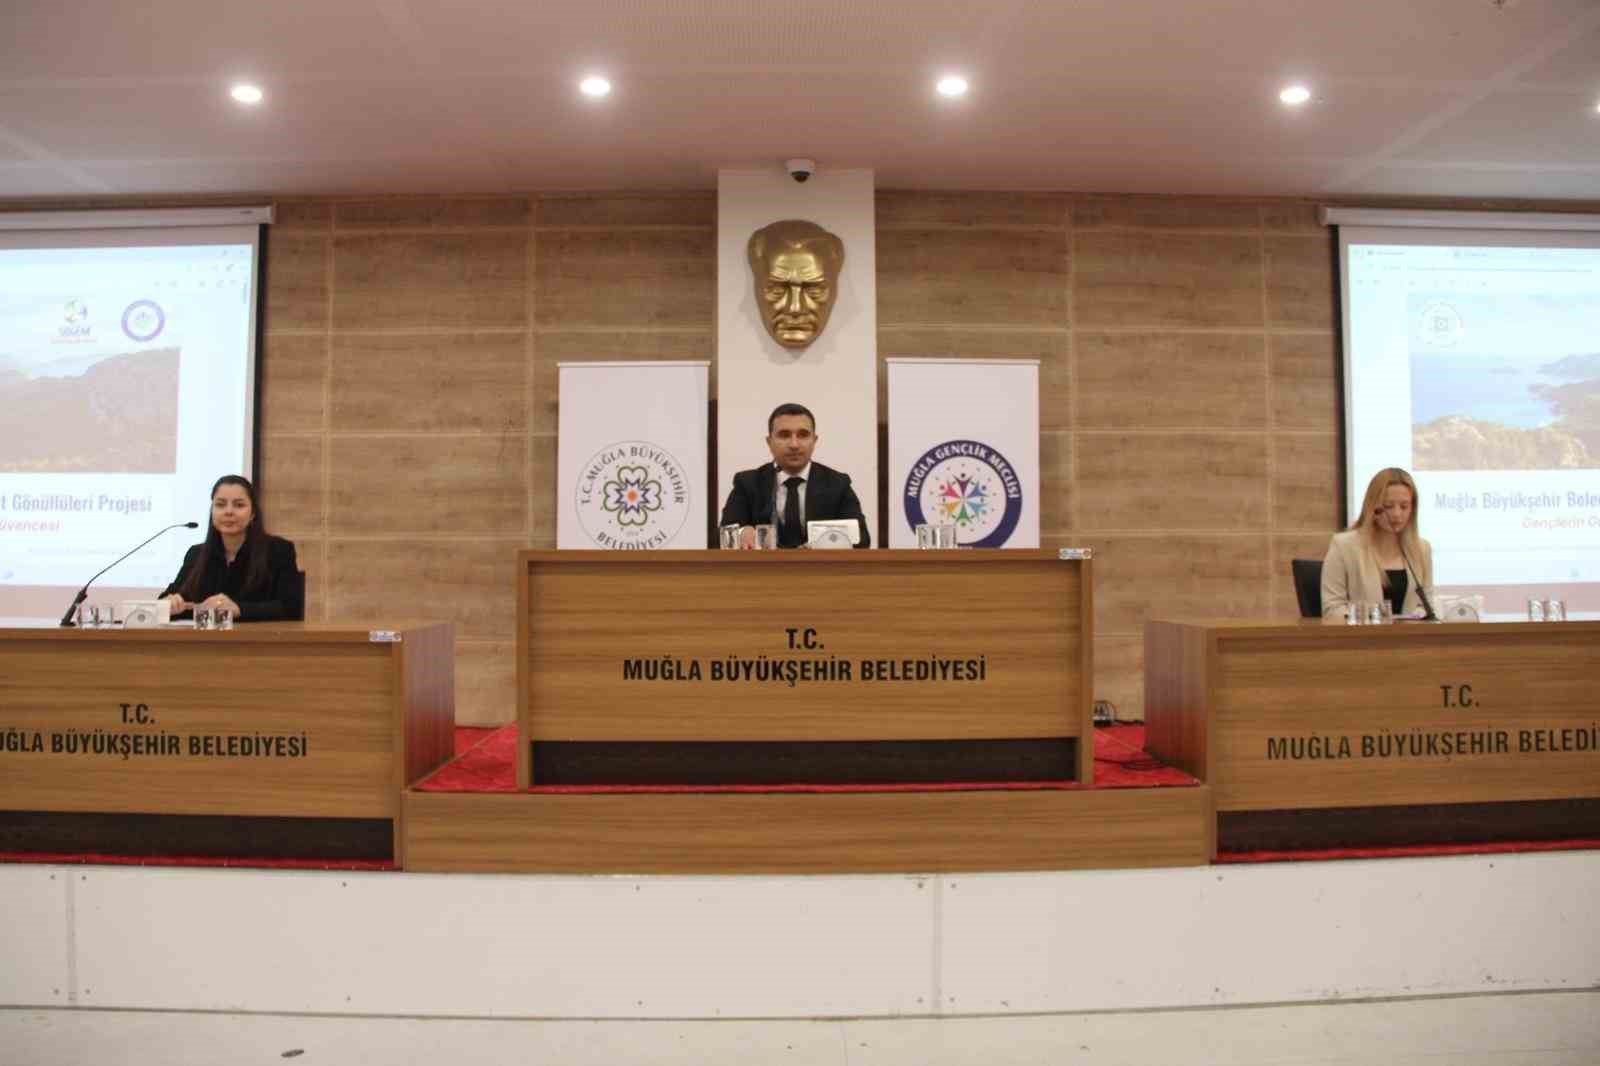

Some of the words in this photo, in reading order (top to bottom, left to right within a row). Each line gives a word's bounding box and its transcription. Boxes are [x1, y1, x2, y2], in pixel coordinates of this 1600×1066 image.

[586, 448, 627, 480] MUĞLA
[629, 445, 686, 503] BÜYÜKŞEHİR
[907, 456, 936, 497] MUĞLA
[934, 442, 989, 460] GENÇLİK
[989, 454, 1020, 498] MECLİSİ
[12, 490, 94, 512] Gönüllüleri
[98, 493, 153, 515] Projesi
[1434, 491, 1478, 513] Muğla
[1482, 489, 1561, 513] Büyükşehir
[1567, 490, 1600, 508] Bele
[597, 529, 667, 549] BELEDİYESİ
[785, 628, 825, 650] T.C.
[623, 654, 702, 681] MUĞLA
[711, 655, 852, 688] BÜYÜKŞEHİR
[860, 654, 986, 681] BELEDİYESİ
[1440, 684, 1480, 708] T.C.
[119, 703, 156, 725] T.C.
[51, 728, 181, 760] BÜYÜKŞEHİR
[188, 730, 308, 757] BELEDİYESİ
[1267, 731, 1352, 760] MUĞLA
[1361, 726, 1509, 763] BÜYÜKŞEHİR
[1518, 721, 1600, 753] BELEDİ
